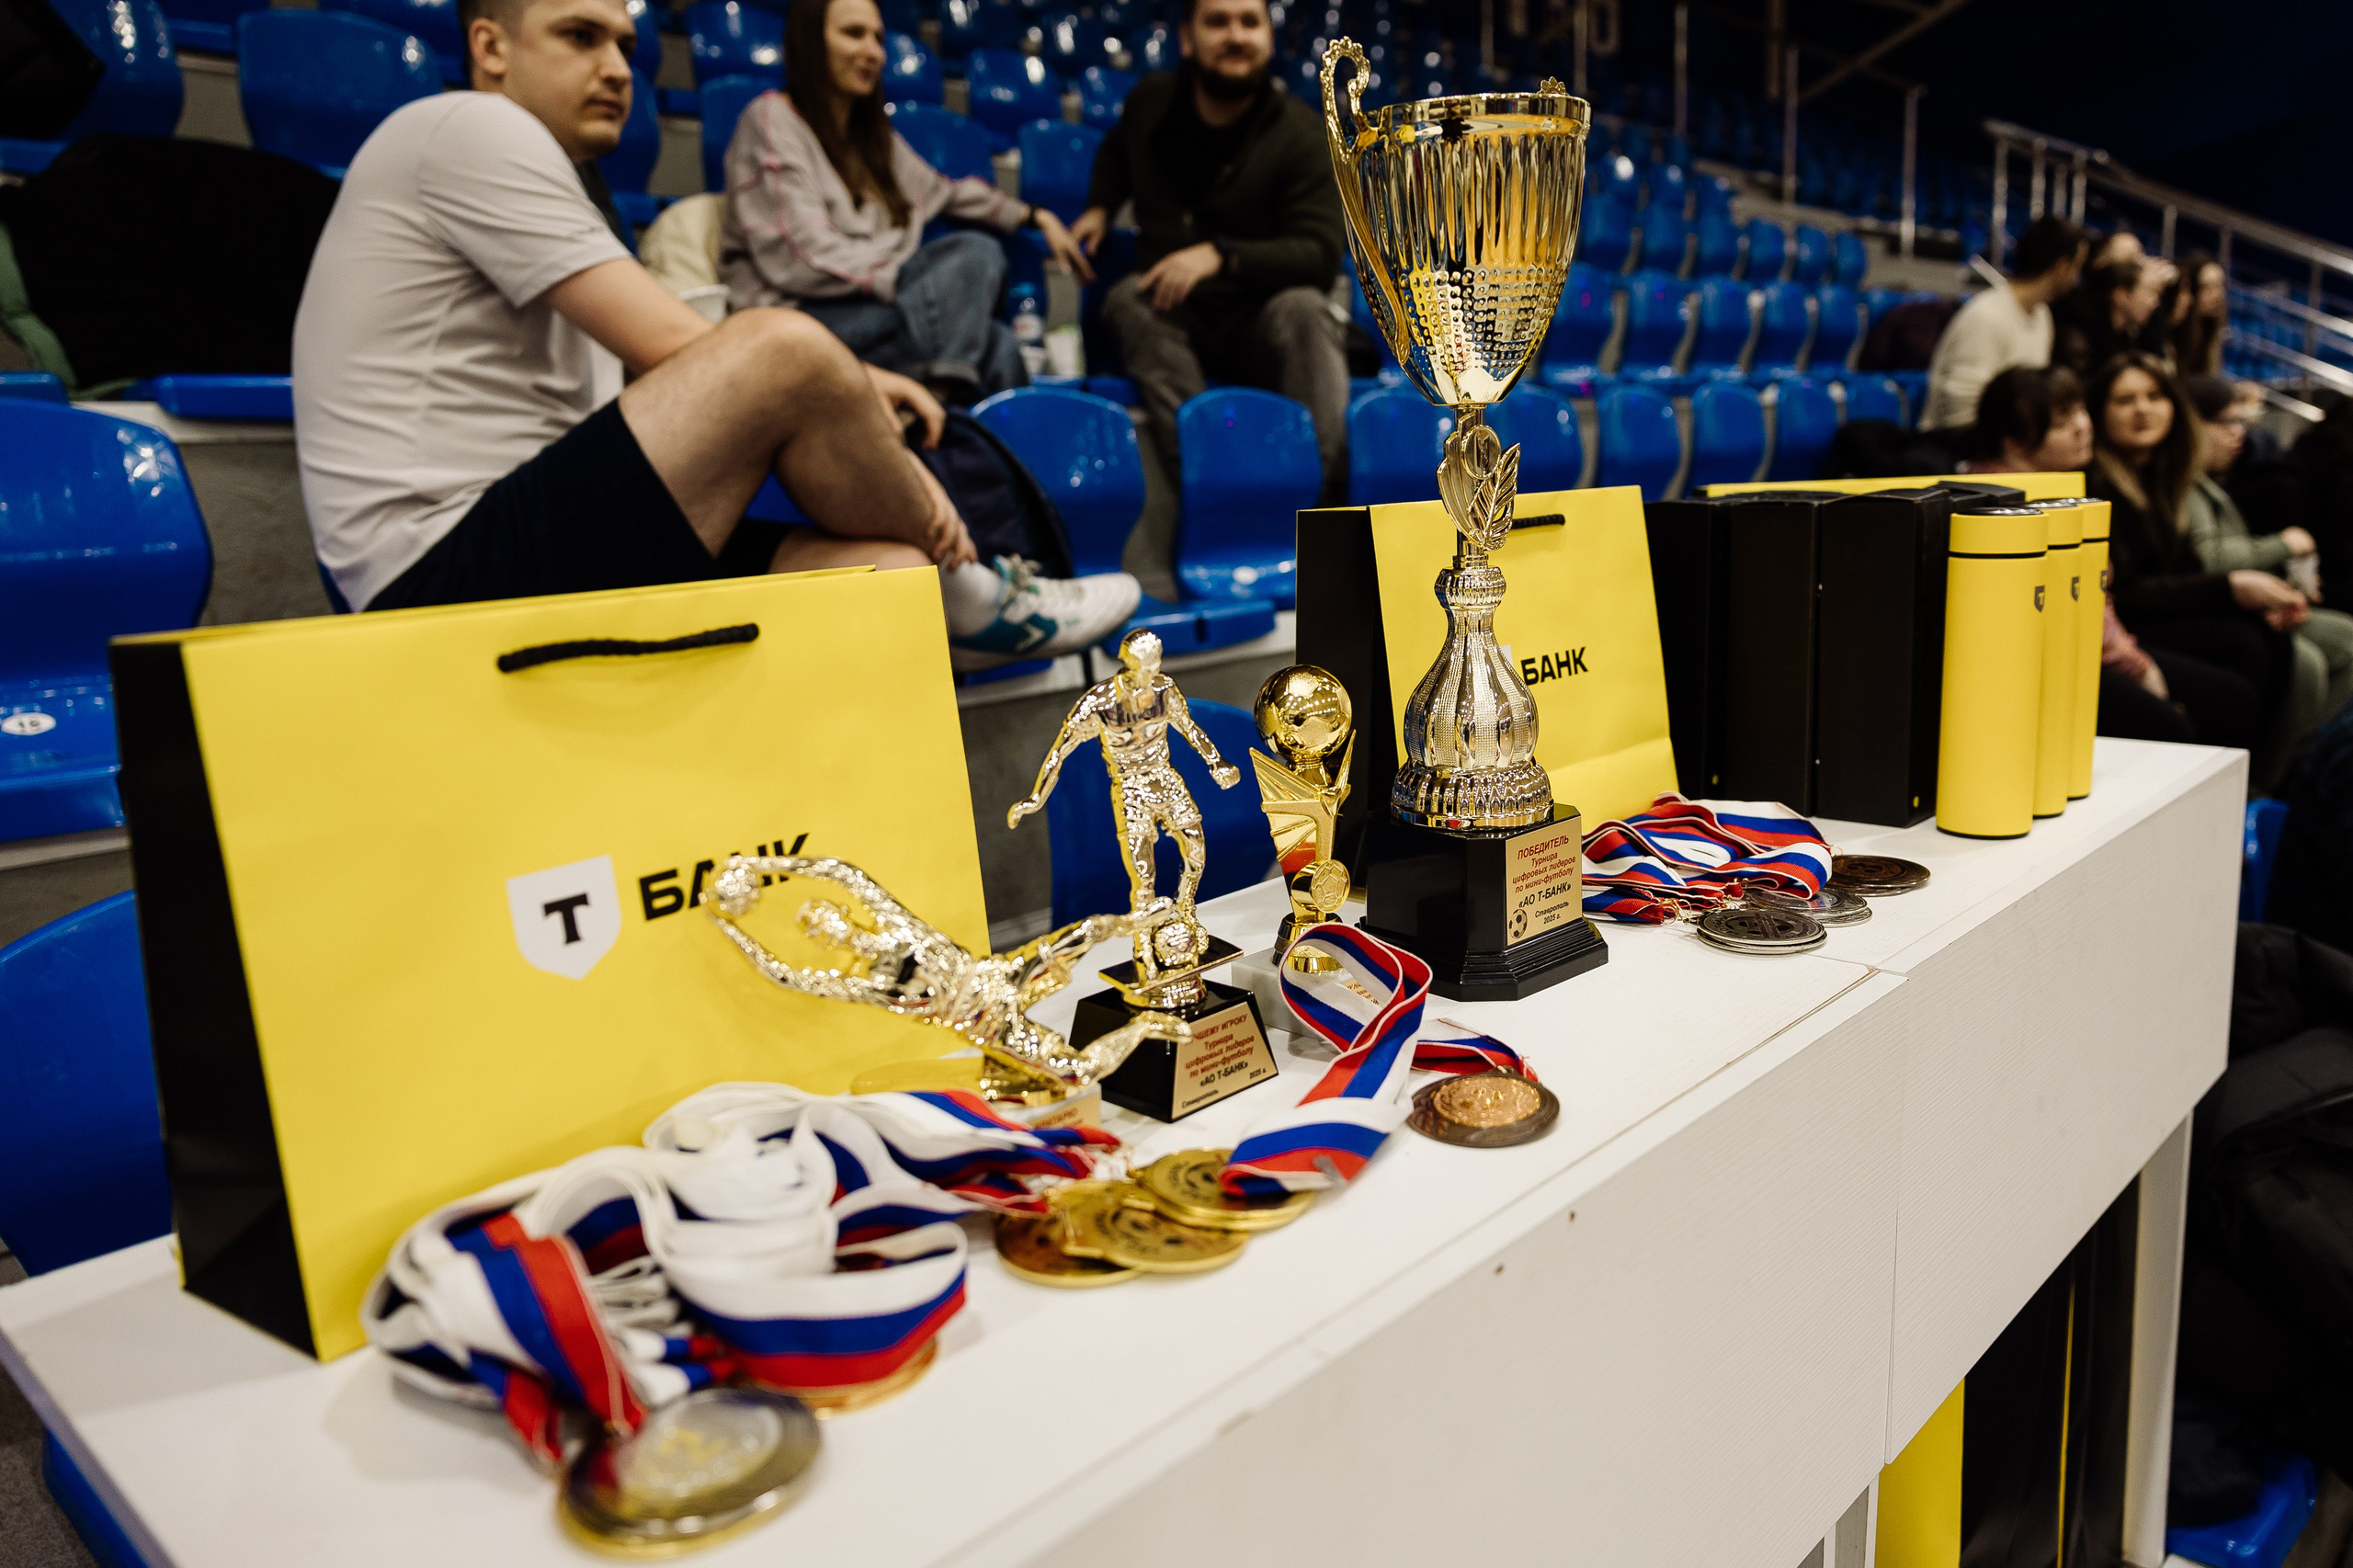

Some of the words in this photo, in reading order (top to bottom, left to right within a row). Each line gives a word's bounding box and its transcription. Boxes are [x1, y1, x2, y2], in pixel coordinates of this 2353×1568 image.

[1520, 646, 1588, 686] БАНК
[1518, 835, 1569, 859] ПОБЕДИТЕЛЬ
[1531, 852, 1558, 867] Турнира
[1512, 866, 1548, 884] цифровых
[1549, 856, 1576, 871] лидеров
[1515, 884, 1524, 893] по
[1525, 867, 1574, 891] мини-футболу
[1518, 894, 1535, 908] «АО
[1538, 881, 1571, 902] Т-БАНК»
[543, 892, 591, 946] Т
[1535, 902, 1569, 918] Ставрополь
[1543, 913, 1555, 925] 2025
[1222, 1013, 1248, 1029] ИГРОКУ
[1186, 1049, 1223, 1069] цифровых
[1225, 1035, 1255, 1053] лидеров
[1204, 1033, 1233, 1051] Турнира
[1189, 1069, 1199, 1079] по
[1200, 1046, 1255, 1074] мини-футболу
[1217, 1060, 1248, 1080] Т-БАНК»
